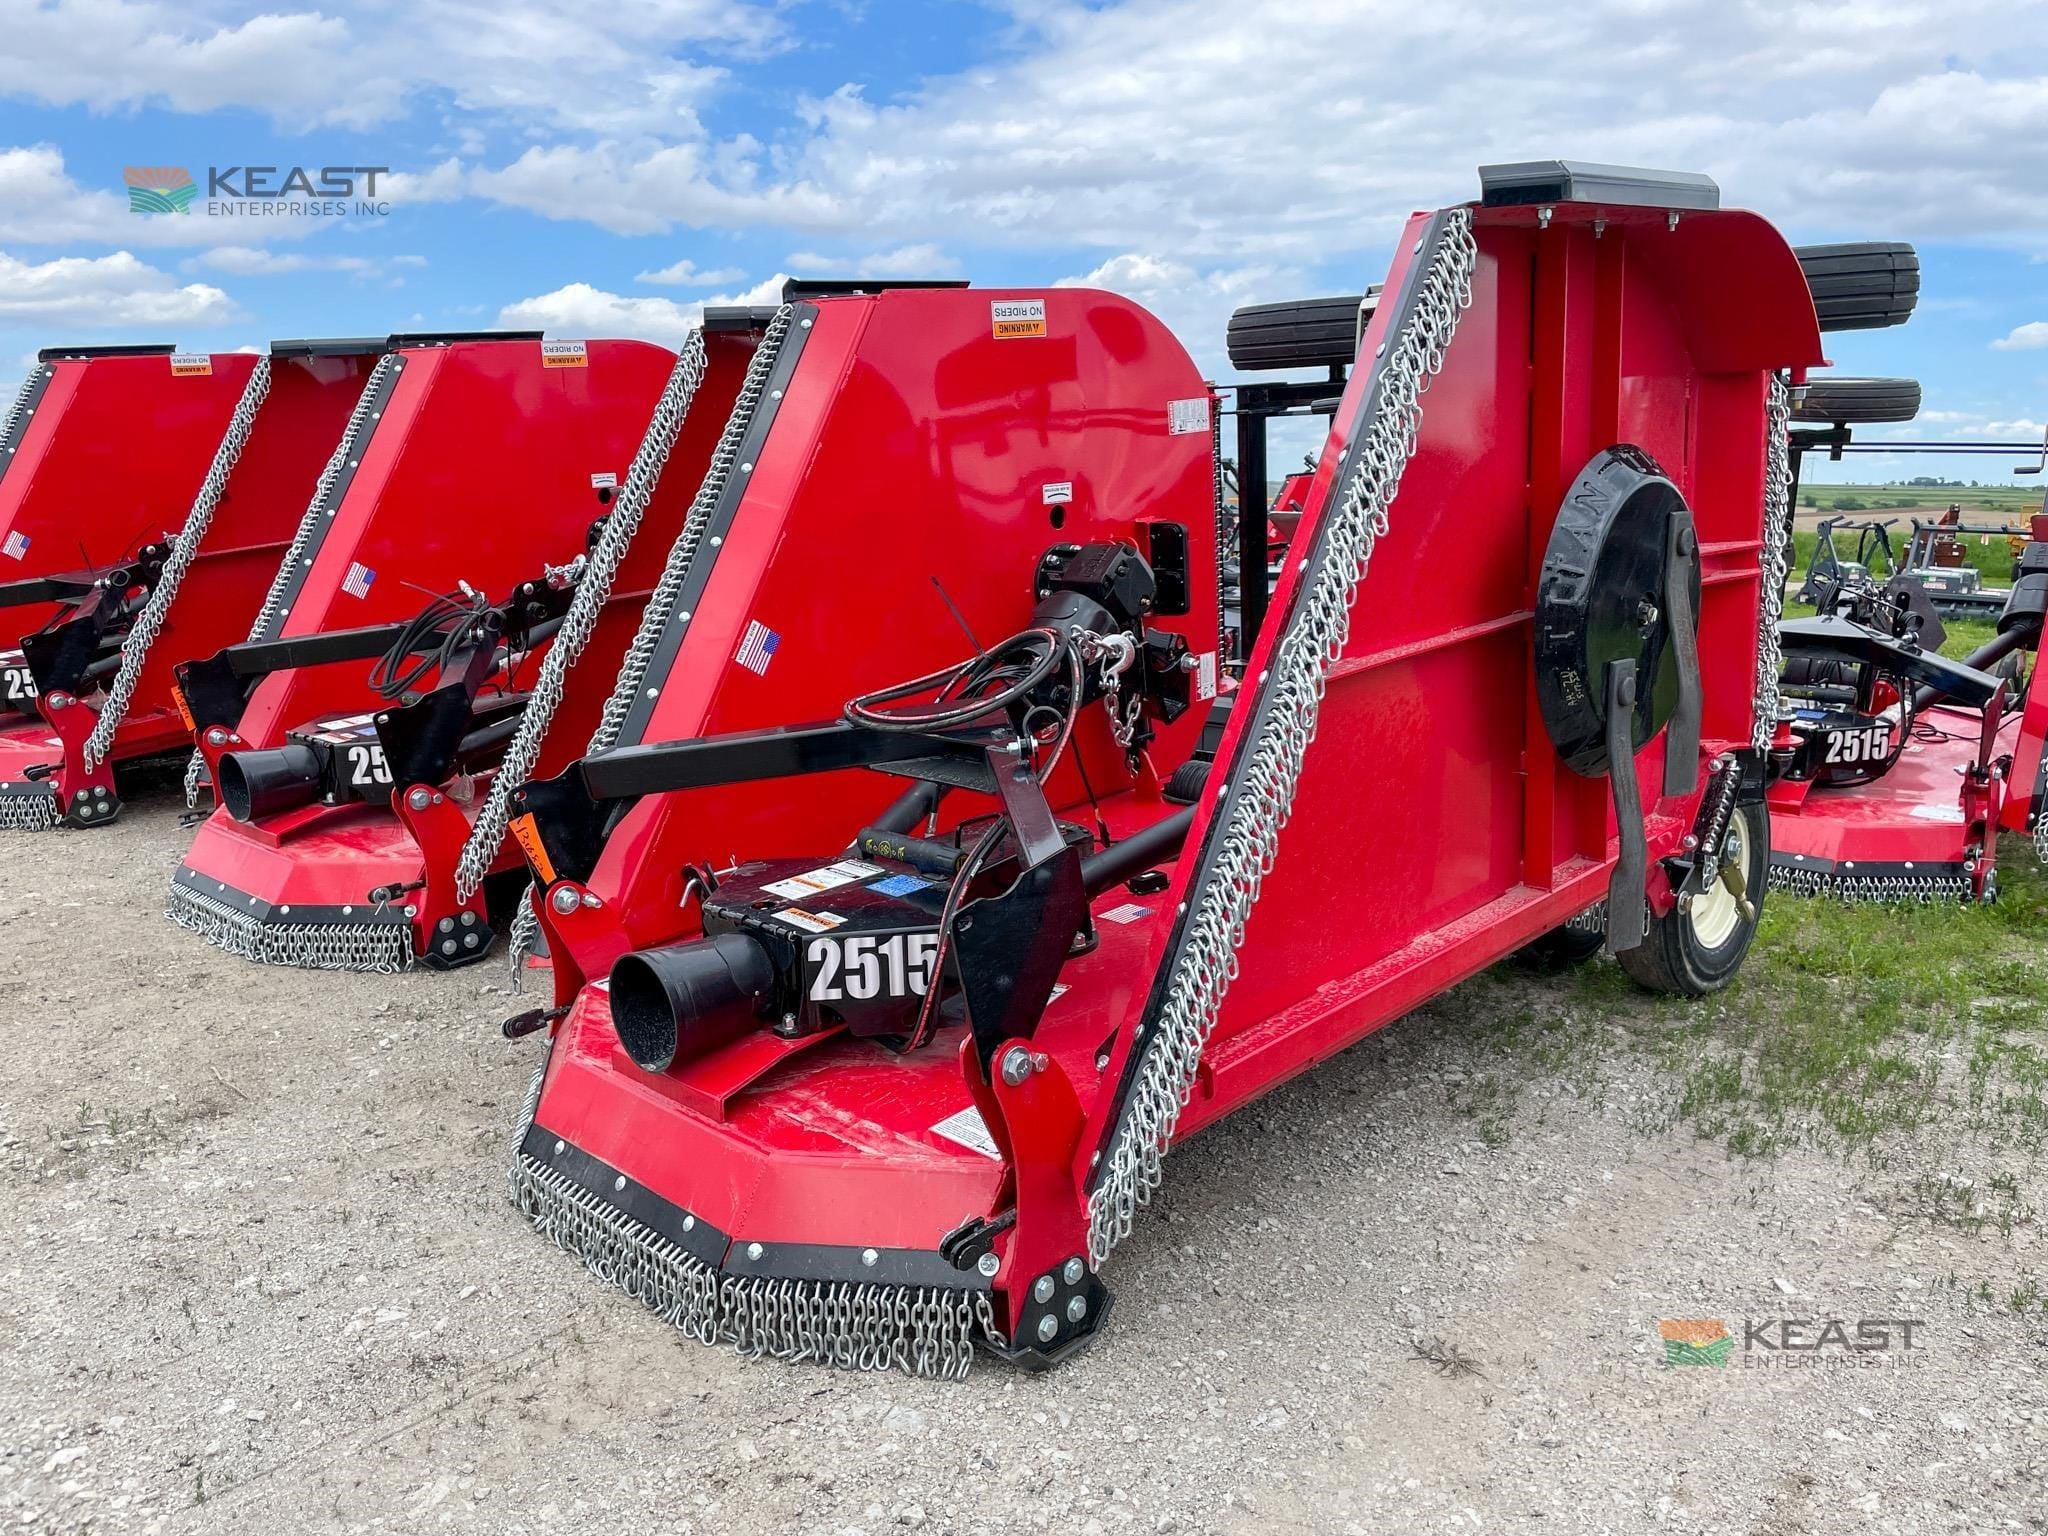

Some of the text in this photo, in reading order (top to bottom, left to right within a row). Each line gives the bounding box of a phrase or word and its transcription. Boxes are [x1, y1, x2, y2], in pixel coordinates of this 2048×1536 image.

[994, 306, 1042, 317] NO RIDERS
[998, 323, 1032, 334] WARNING
[1825, 727, 1890, 764] 2515
[807, 935, 939, 1001] 2515
